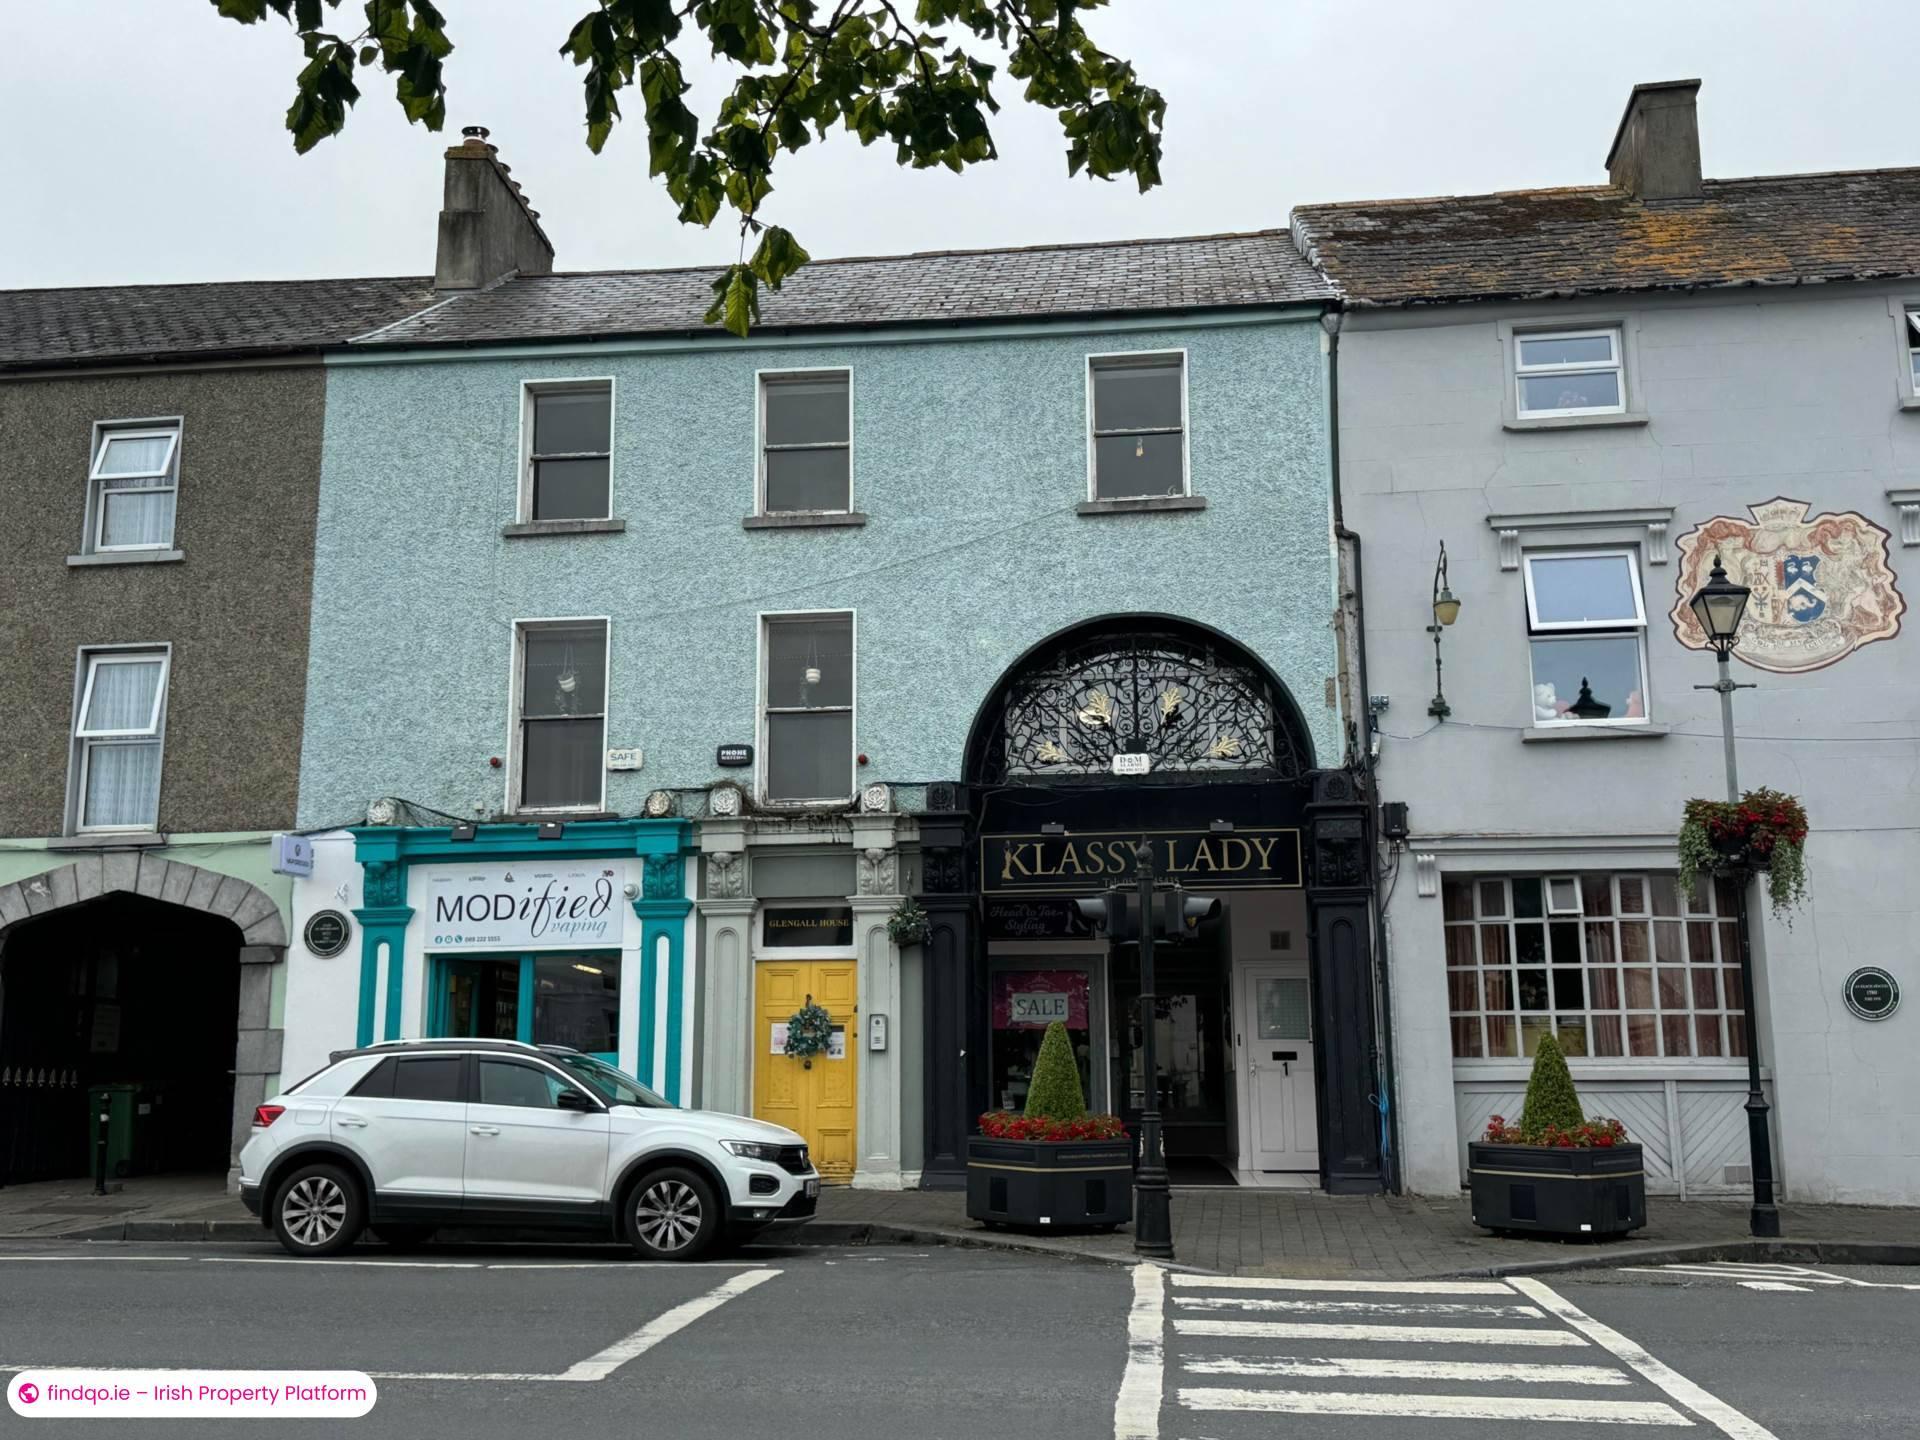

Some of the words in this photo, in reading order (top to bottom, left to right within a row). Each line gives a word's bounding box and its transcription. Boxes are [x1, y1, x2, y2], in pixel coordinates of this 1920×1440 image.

[610, 752, 637, 761] SAFE
[1001, 839, 1151, 880] KLASSY
[1166, 836, 1279, 872] LADY
[436, 877, 613, 938] MODified
[550, 916, 608, 938] vaping
[768, 919, 817, 928] GLENGALL
[819, 918, 849, 927] HOUSE
[1005, 917, 1050, 936] Styling
[1016, 998, 1065, 1016] SALE
[1282, 1062, 1289, 1076] 1
